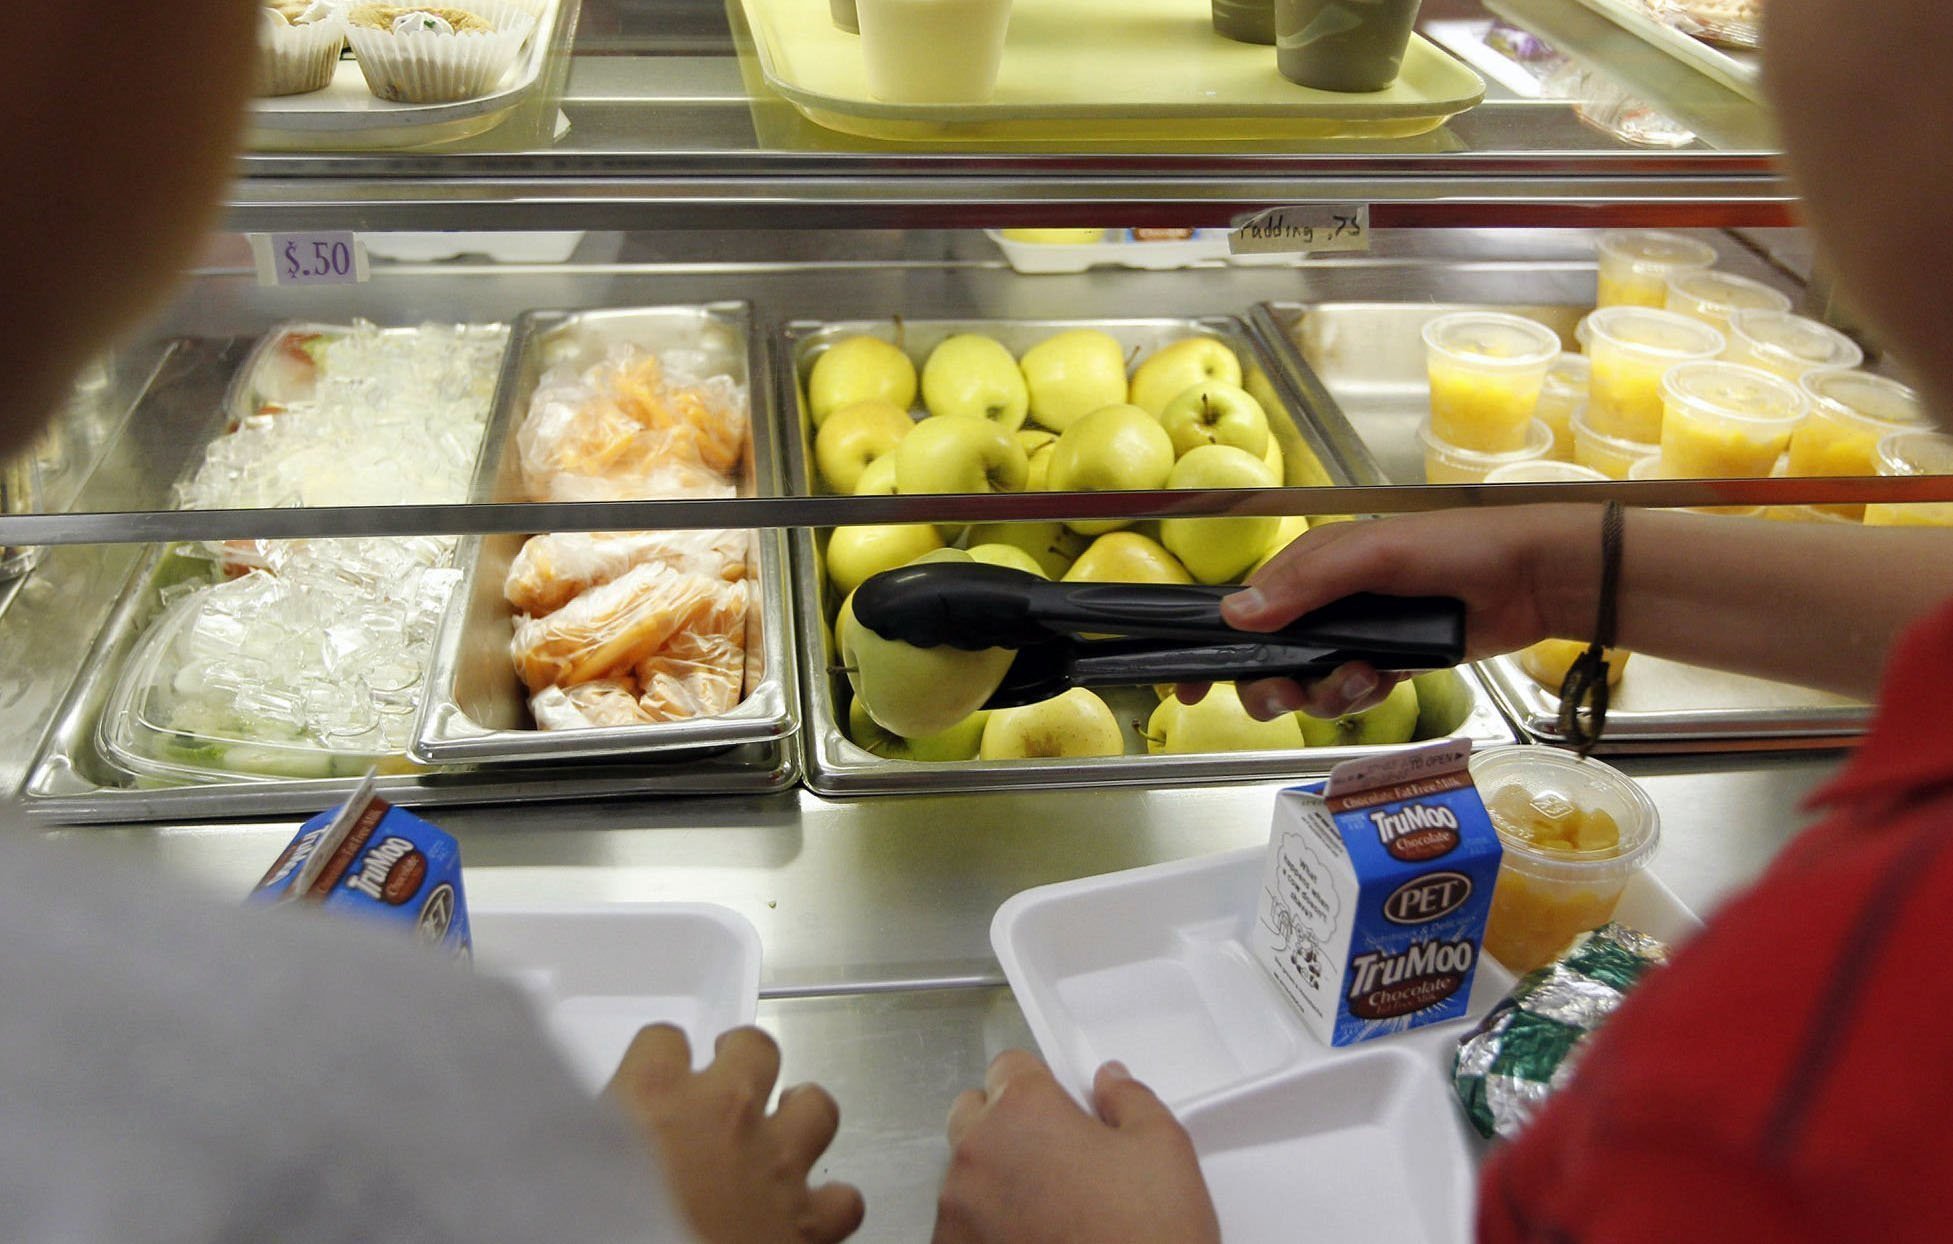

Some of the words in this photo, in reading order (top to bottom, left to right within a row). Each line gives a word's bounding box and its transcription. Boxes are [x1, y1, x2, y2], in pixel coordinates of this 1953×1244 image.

[285, 240, 350, 279] $.50
[1370, 804, 1459, 843] TruMoo
[1396, 831, 1450, 851] Chocolate
[347, 836, 415, 899] TruMoo
[1398, 880, 1459, 917] PET
[1349, 941, 1472, 998] TruMoo
[1368, 977, 1451, 1007] Chocolate
